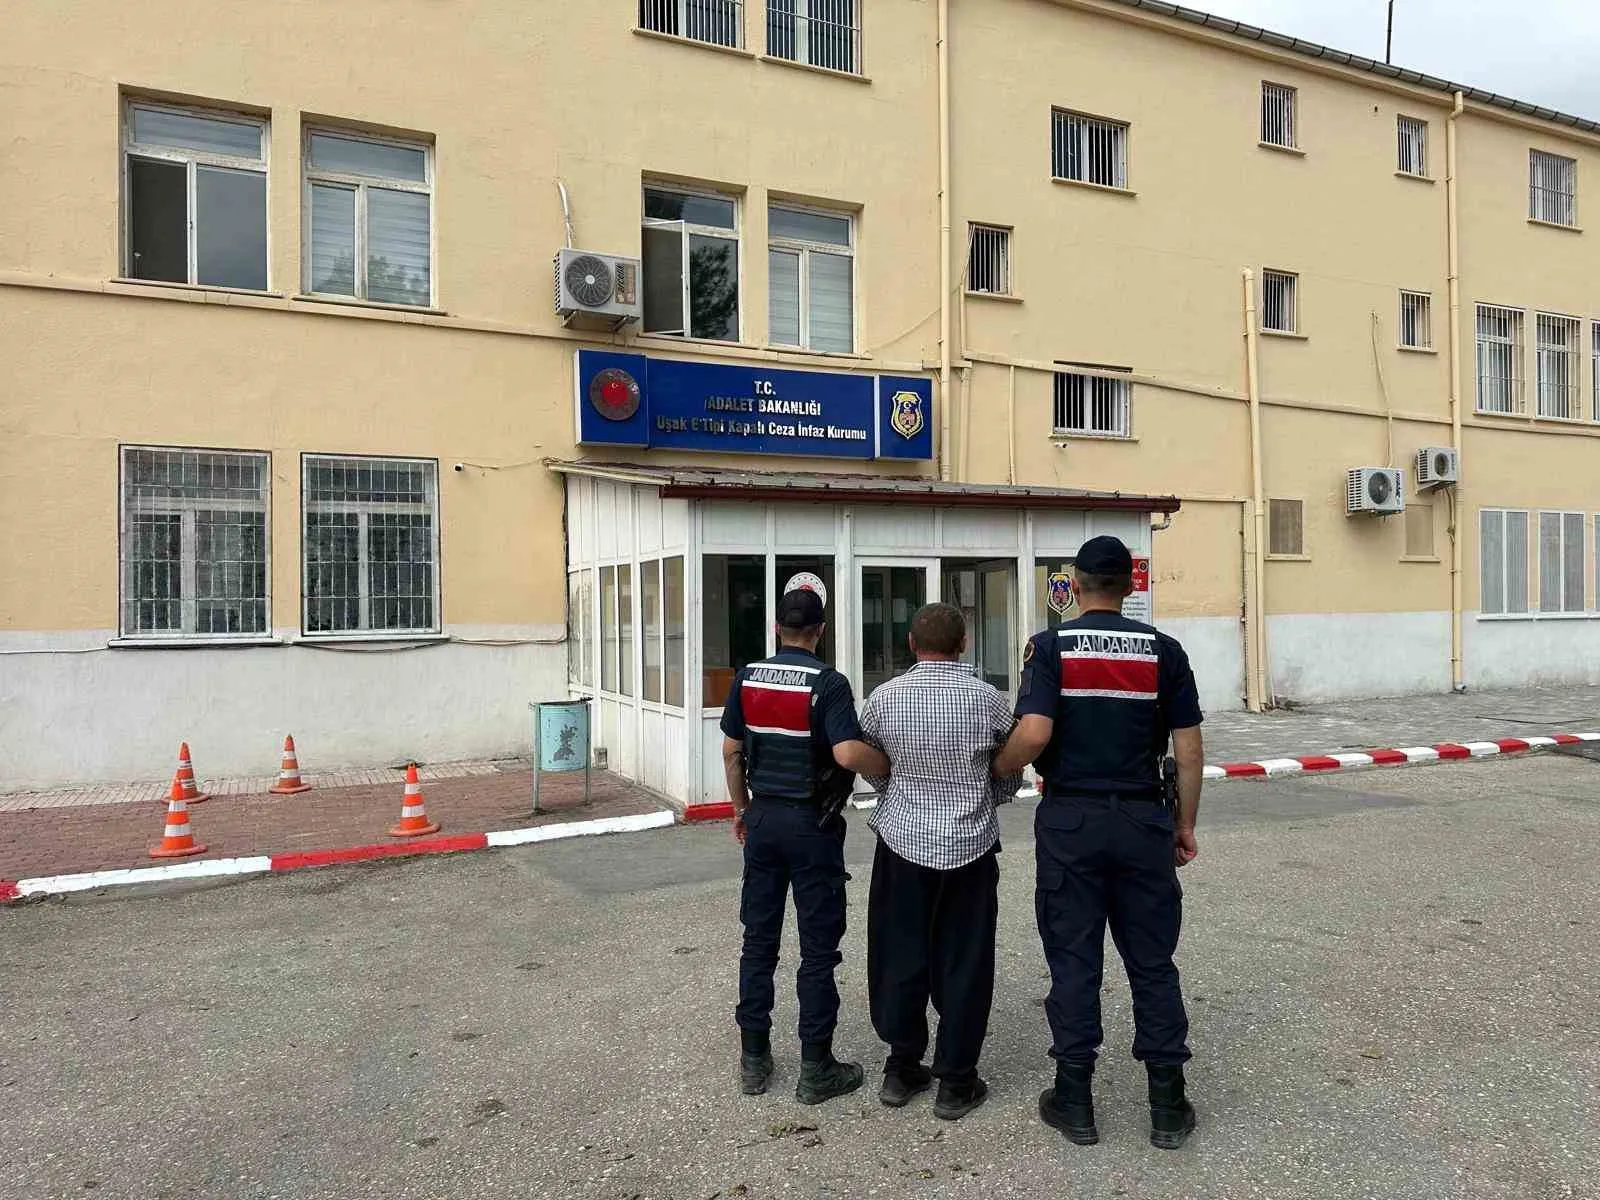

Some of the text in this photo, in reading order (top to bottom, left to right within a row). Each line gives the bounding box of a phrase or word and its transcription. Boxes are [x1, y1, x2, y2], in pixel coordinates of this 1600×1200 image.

[754, 380, 776, 395] T.C.
[707, 395, 821, 416] ADALET BAKANLIĞI
[656, 416, 688, 433] Uşak
[728, 419, 765, 436] Kapalı
[768, 421, 796, 437] Ceza
[797, 421, 825, 438] İnfaz
[827, 425, 867, 440] Kurumu
[1073, 634, 1153, 655] JANDARMA
[749, 668, 807, 686] JANDARMA
